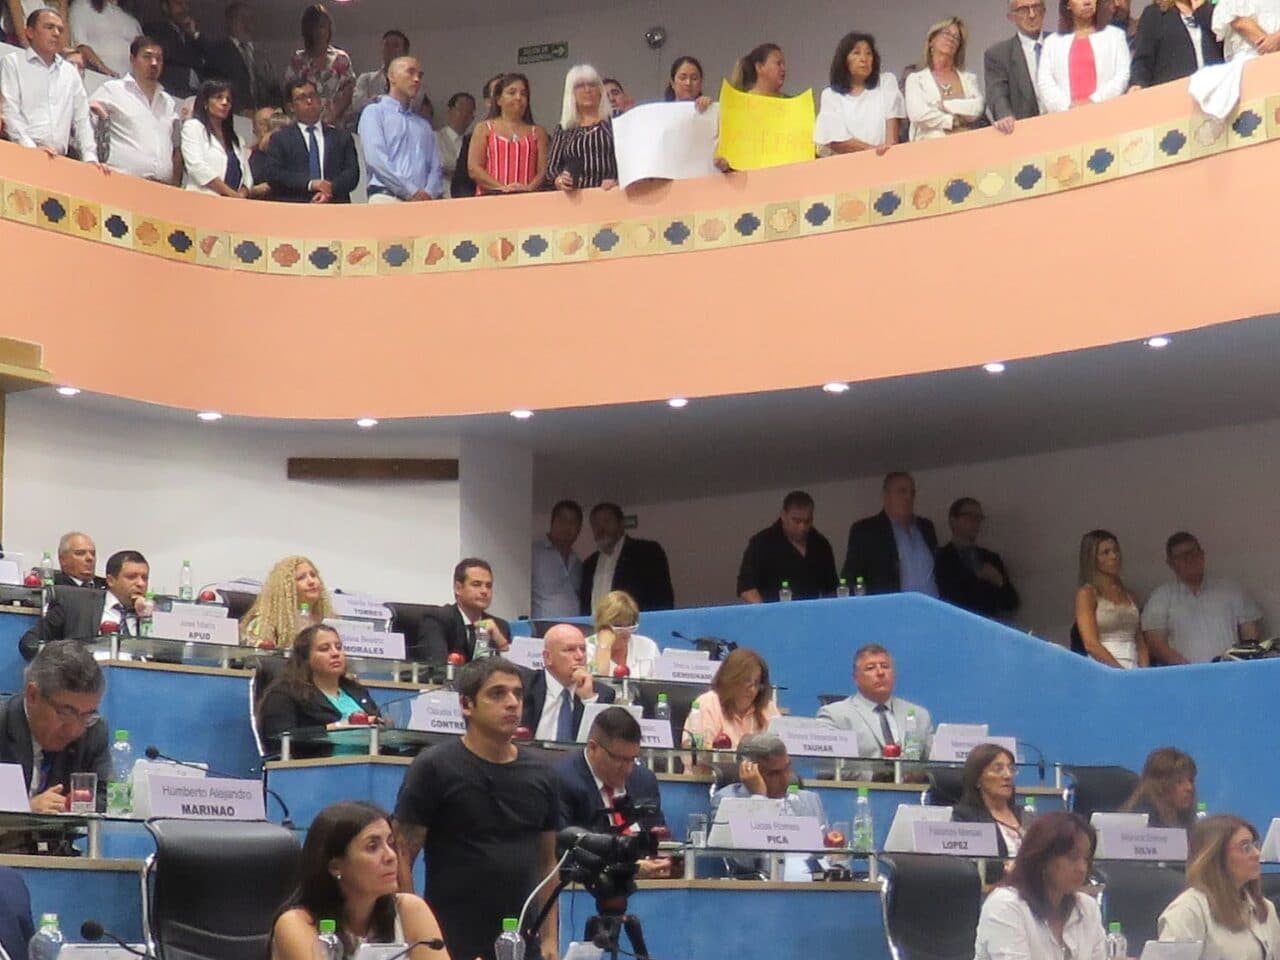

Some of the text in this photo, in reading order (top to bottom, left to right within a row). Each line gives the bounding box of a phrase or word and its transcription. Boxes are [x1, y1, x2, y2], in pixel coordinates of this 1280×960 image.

[188, 631, 211, 641] APUD
[430, 719, 466, 730] CONTRE
[162, 785, 253, 801] Humberto Alejandro
[181, 804, 235, 817] MARINAO
[766, 834, 789, 845] PICA
[942, 840, 969, 850] LOPEZ
